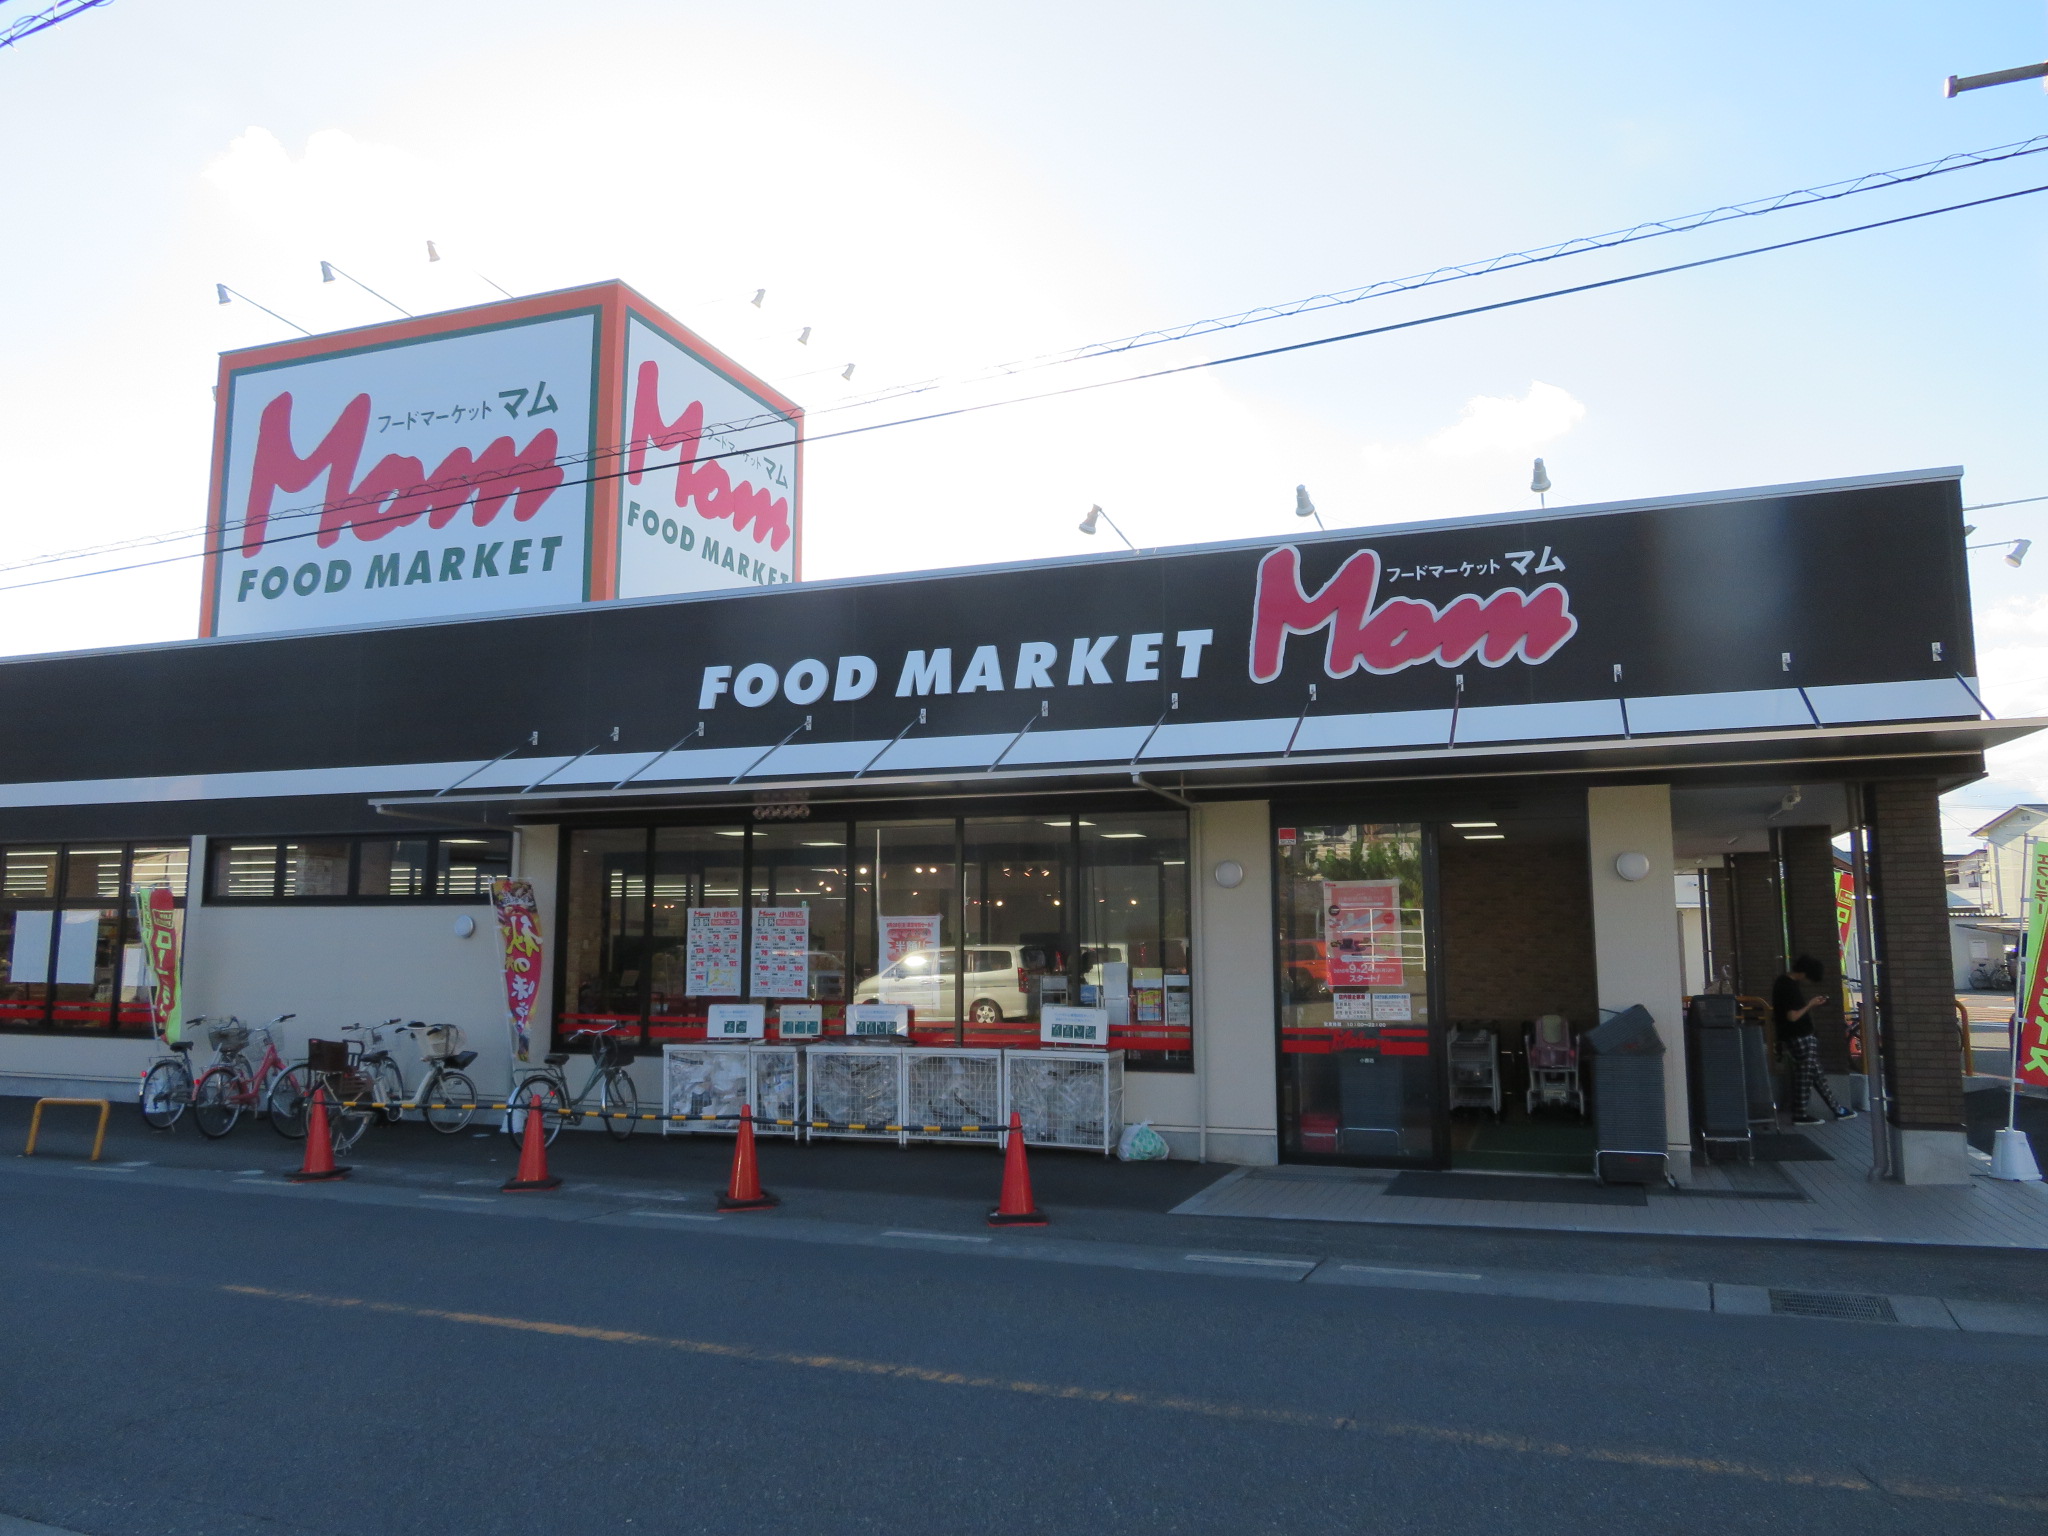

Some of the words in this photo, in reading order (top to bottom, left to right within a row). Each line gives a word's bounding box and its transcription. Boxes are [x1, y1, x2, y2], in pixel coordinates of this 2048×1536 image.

[378, 401, 492, 434] フードマーケット
[497, 380, 559, 421] マム
[242, 391, 564, 558] Mom
[627, 360, 790, 552] Mom
[707, 427, 761, 470] フードマケット
[763, 456, 789, 490] マム
[627, 500, 695, 551] FOOD
[237, 559, 352, 603] FOOD
[365, 535, 563, 591] MARKET
[1387, 559, 1500, 583] フードマーケット
[1505, 546, 1566, 575] マム
[1250, 543, 1578, 684] Mom
[698, 656, 878, 709] FOOD
[895, 629, 1213, 697] MARKET
